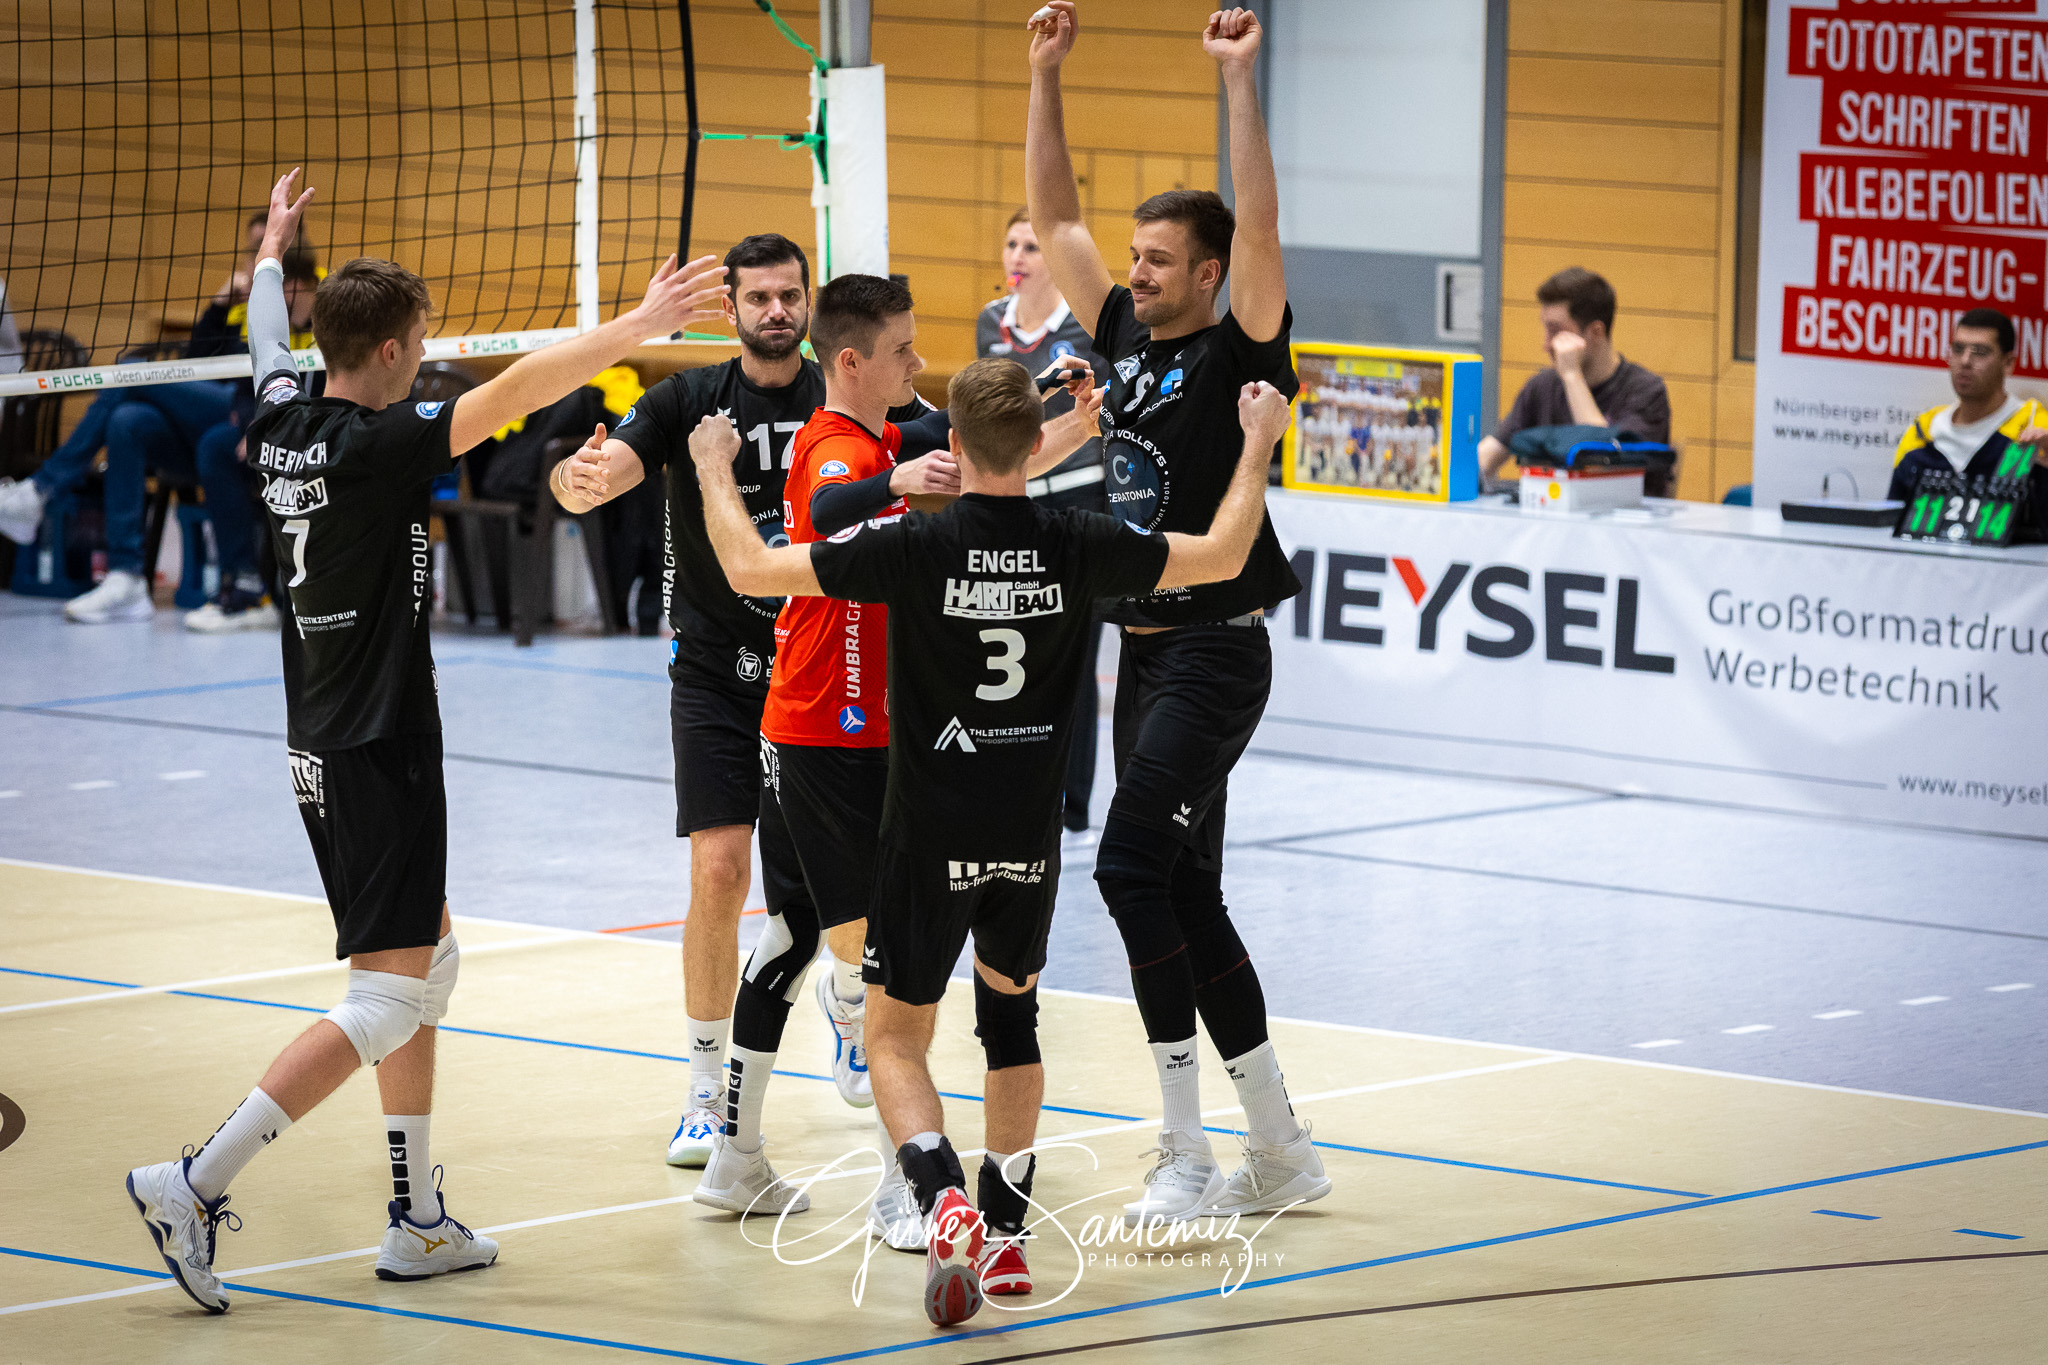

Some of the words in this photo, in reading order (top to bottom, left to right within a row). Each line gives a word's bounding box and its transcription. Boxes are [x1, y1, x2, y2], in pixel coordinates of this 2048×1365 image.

[1806, 18, 2048, 83] FOTOTAPETEN
[1836, 90, 2030, 157] SCHRIFTEN
[1813, 165, 2048, 226] KLEBEFOLIEN
[1829, 235, 2038, 302] FAHRZEUG-
[472, 338, 518, 353] FUCHS
[53, 373, 103, 388] FUCHS
[113, 371, 142, 384] Ideen
[145, 366, 195, 380] umsetzen
[746, 421, 805, 470] 17
[1117, 429, 1167, 468] VOLLEYS
[281, 519, 310, 587] 7
[967, 549, 1046, 573] ENGEL
[944, 578, 1013, 611] HART
[1014, 581, 1040, 590] GmbH
[1014, 588, 1058, 616] BAU
[975, 628, 1026, 701] 3
[1704, 647, 2000, 713] Werbetechnik
[694, 1045, 719, 1053] erima
[1166, 1059, 1194, 1070] erima
